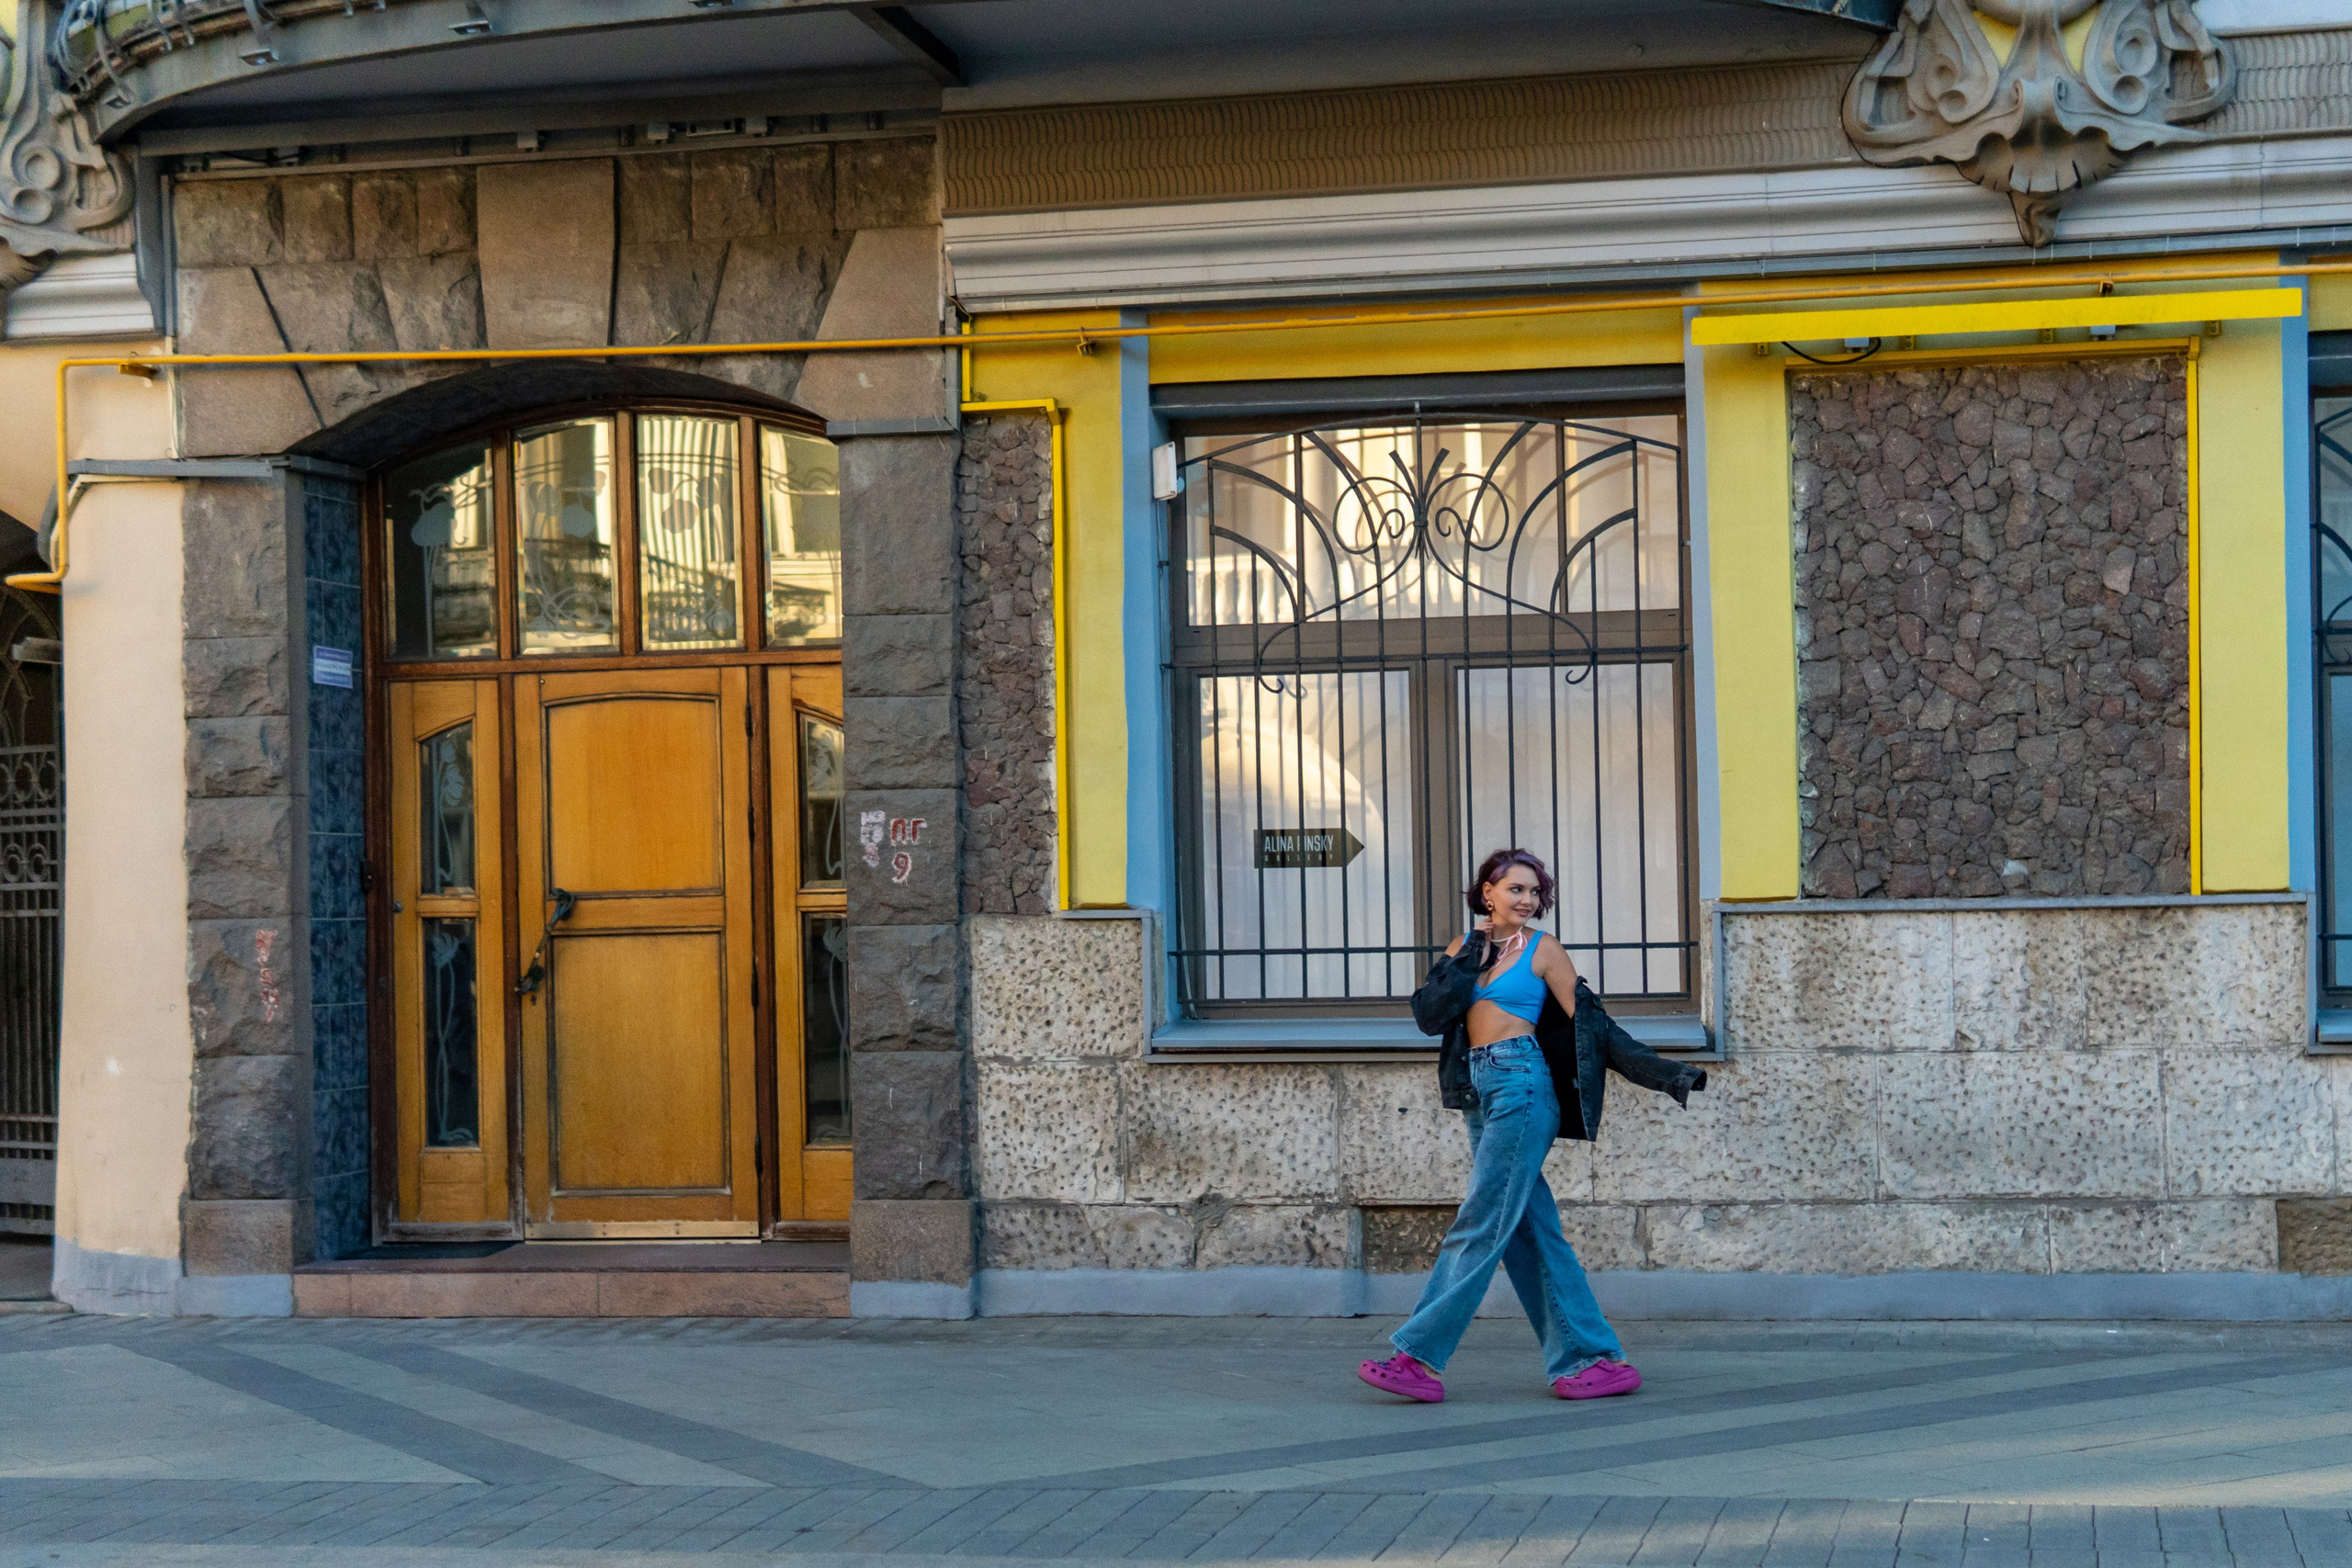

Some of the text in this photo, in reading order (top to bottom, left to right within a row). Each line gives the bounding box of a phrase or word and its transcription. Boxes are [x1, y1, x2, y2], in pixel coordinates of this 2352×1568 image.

[1264, 836, 1294, 852] ALINA
[1265, 853, 1334, 862] GALLERY
[892, 852, 911, 882] 9
